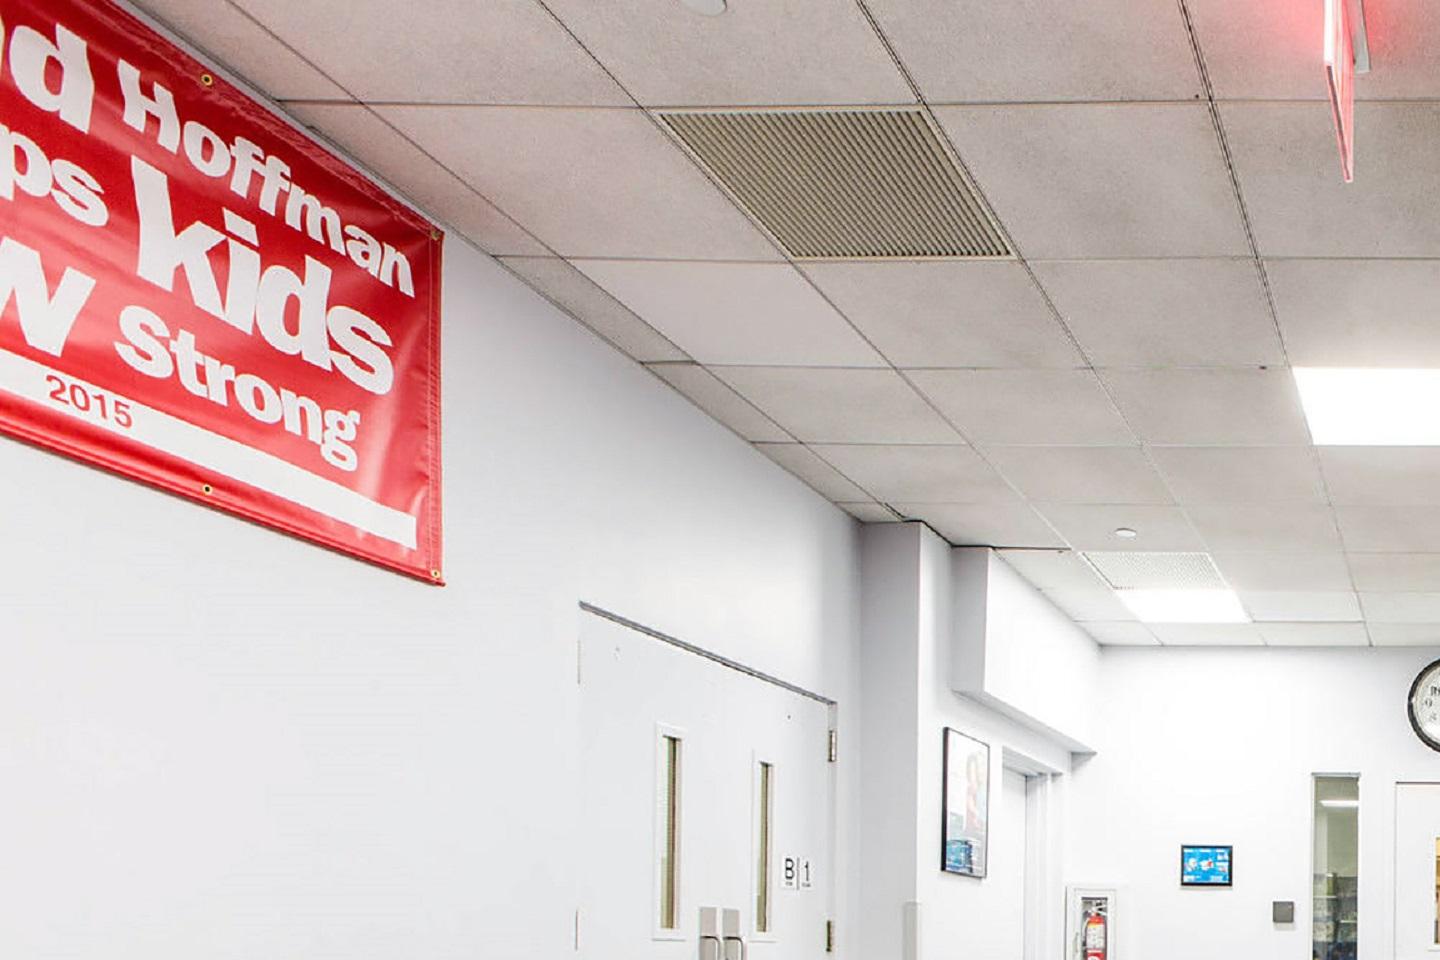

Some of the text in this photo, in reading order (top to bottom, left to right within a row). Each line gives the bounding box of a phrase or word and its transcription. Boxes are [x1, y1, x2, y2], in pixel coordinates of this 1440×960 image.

[117, 57, 415, 298] Hoffman
[131, 154, 393, 395] kids
[46, 375, 133, 429] 2015
[784, 857, 810, 882] B 1
